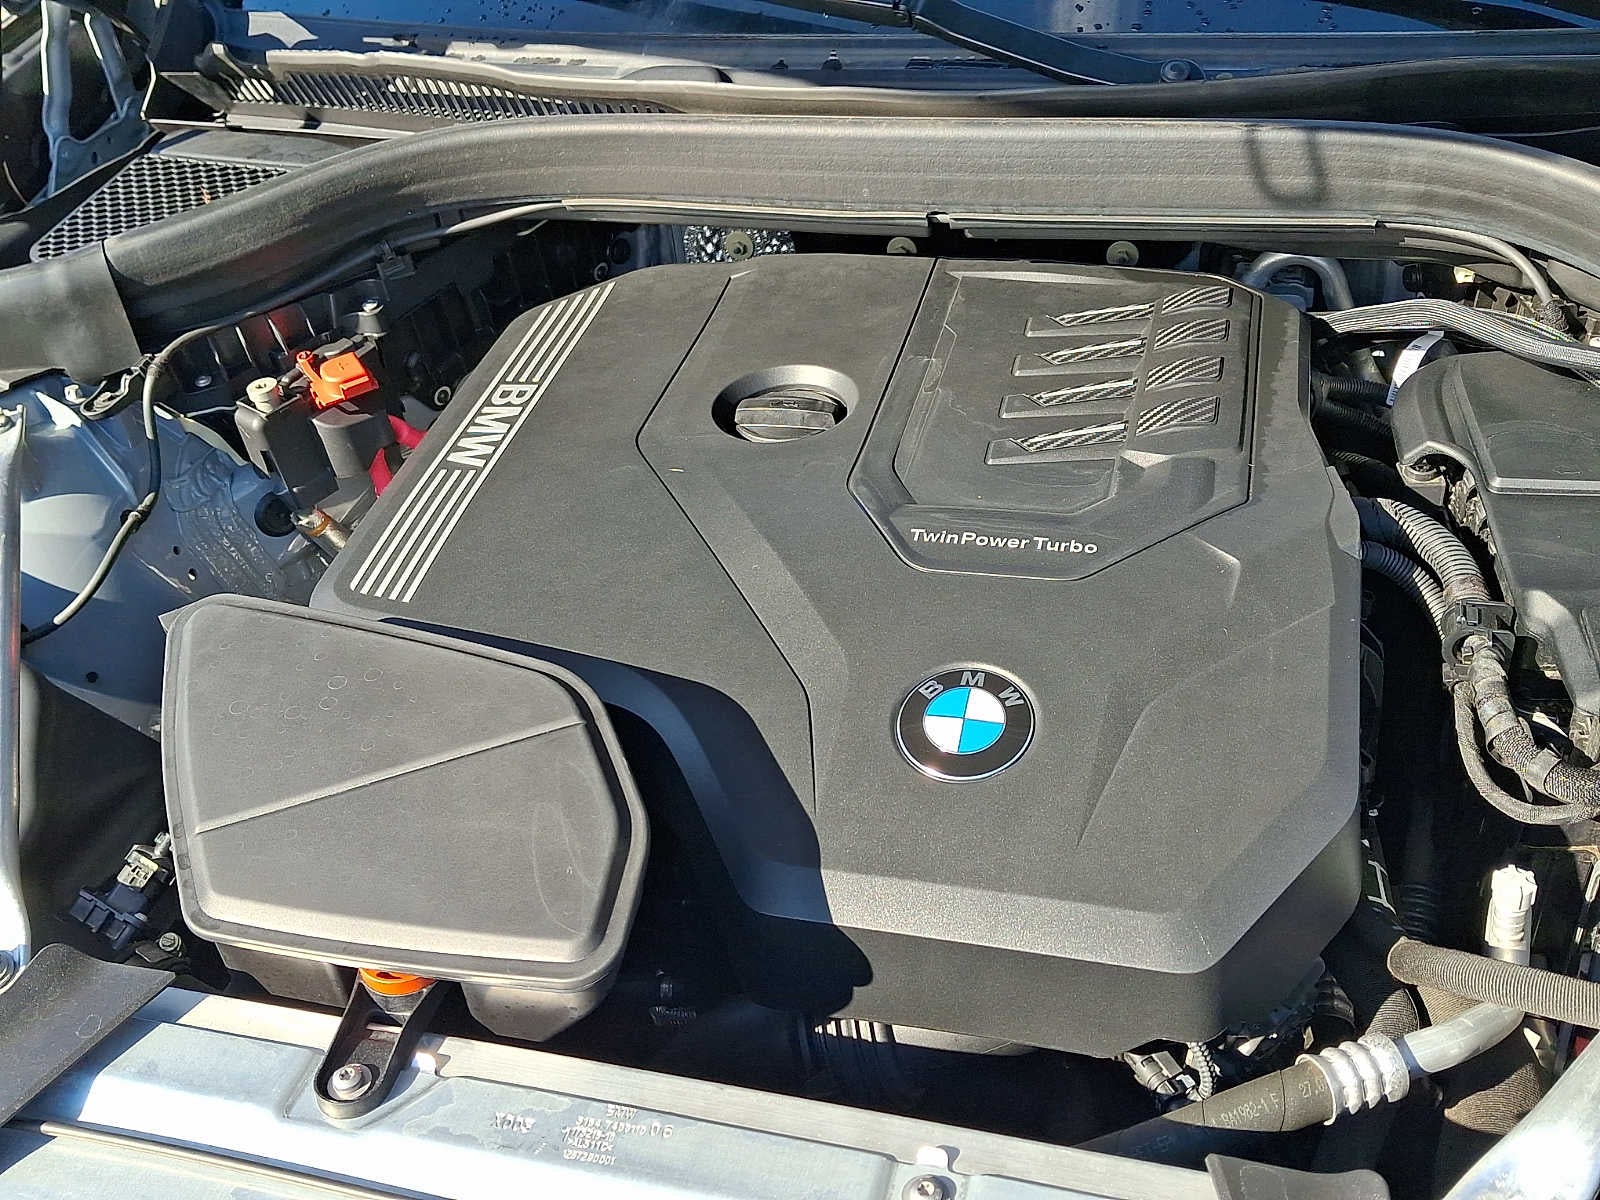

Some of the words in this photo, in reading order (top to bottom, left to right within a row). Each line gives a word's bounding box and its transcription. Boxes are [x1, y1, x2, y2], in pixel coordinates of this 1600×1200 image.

[446, 384, 539, 468] BMW
[910, 528, 1029, 549] TwinPower
[1033, 536, 1098, 554] Turbo
[919, 671, 1024, 707] BMW
